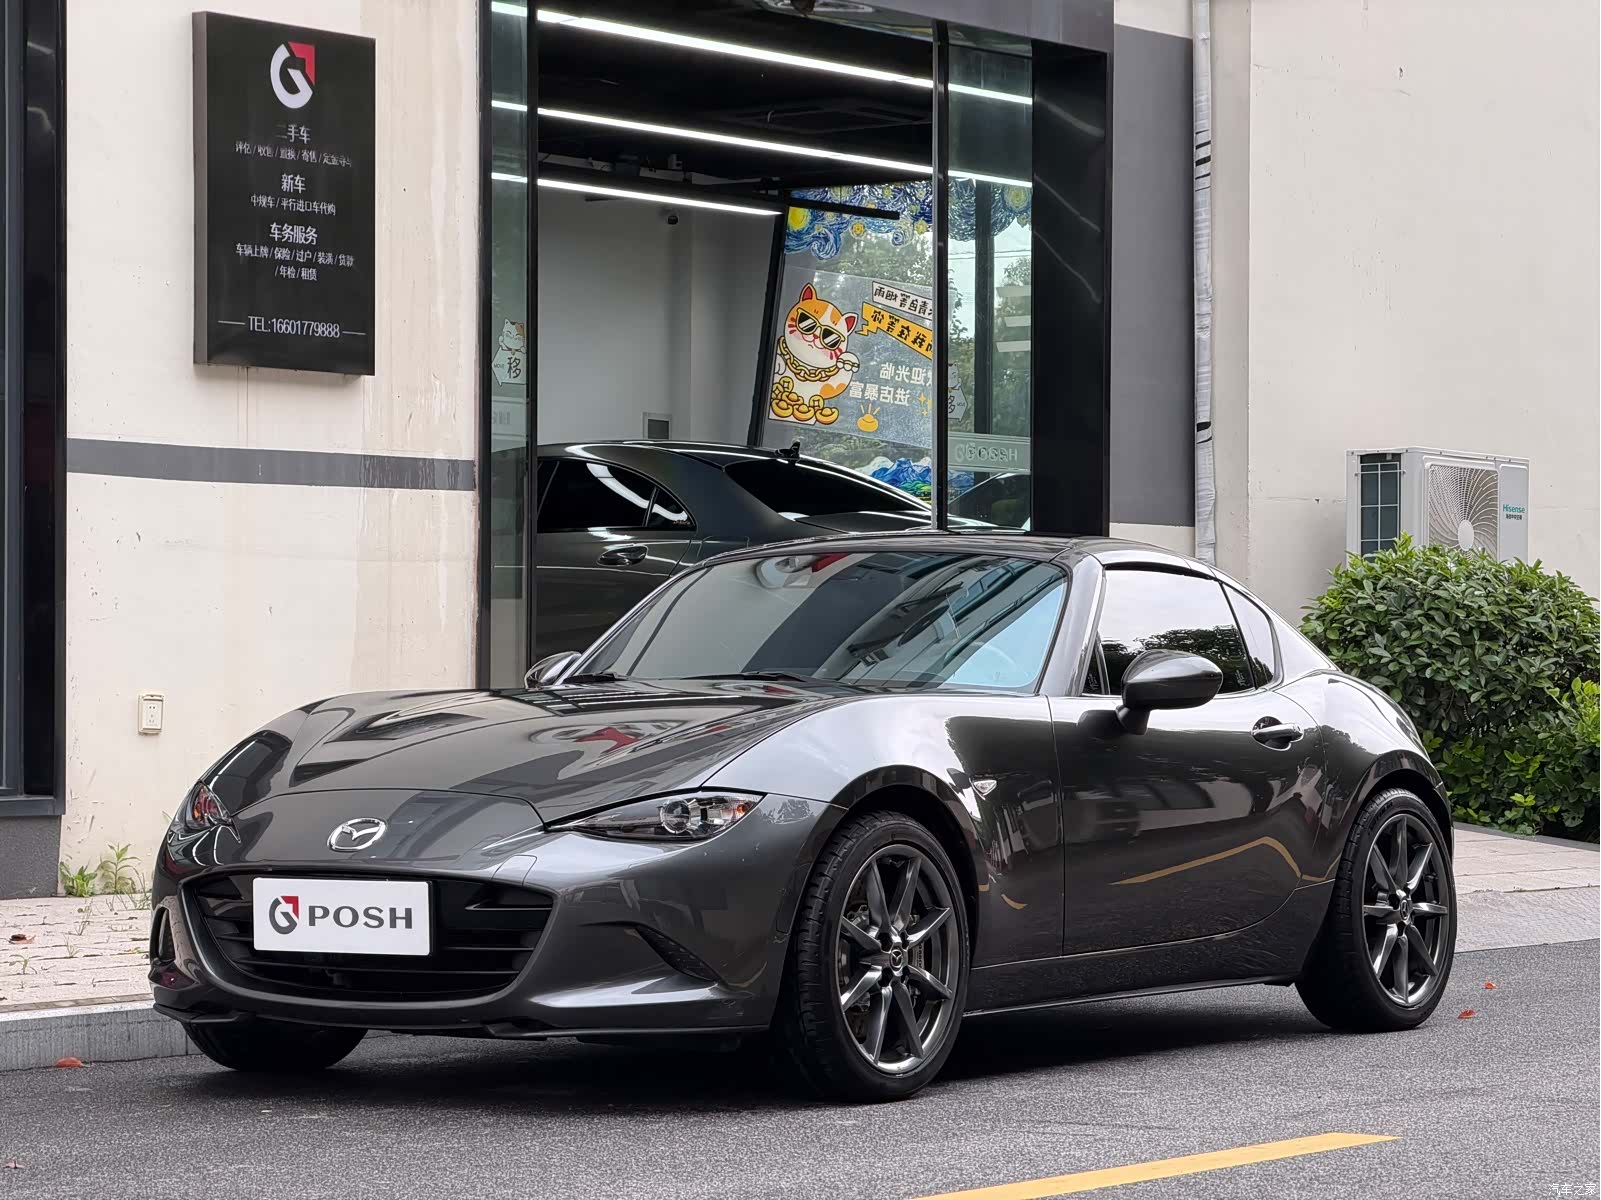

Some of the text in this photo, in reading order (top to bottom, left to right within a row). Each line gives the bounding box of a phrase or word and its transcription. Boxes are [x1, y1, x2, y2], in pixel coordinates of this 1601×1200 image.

[275, 124, 311, 144] 二手车
[281, 173, 306, 194] 新车
[269, 222, 318, 245] 车务服务
[248, 316, 340, 338] TEL:16601779888
[507, 357, 521, 379] 移
[1502, 504, 1525, 513] Hisense
[308, 905, 413, 930] POSH
